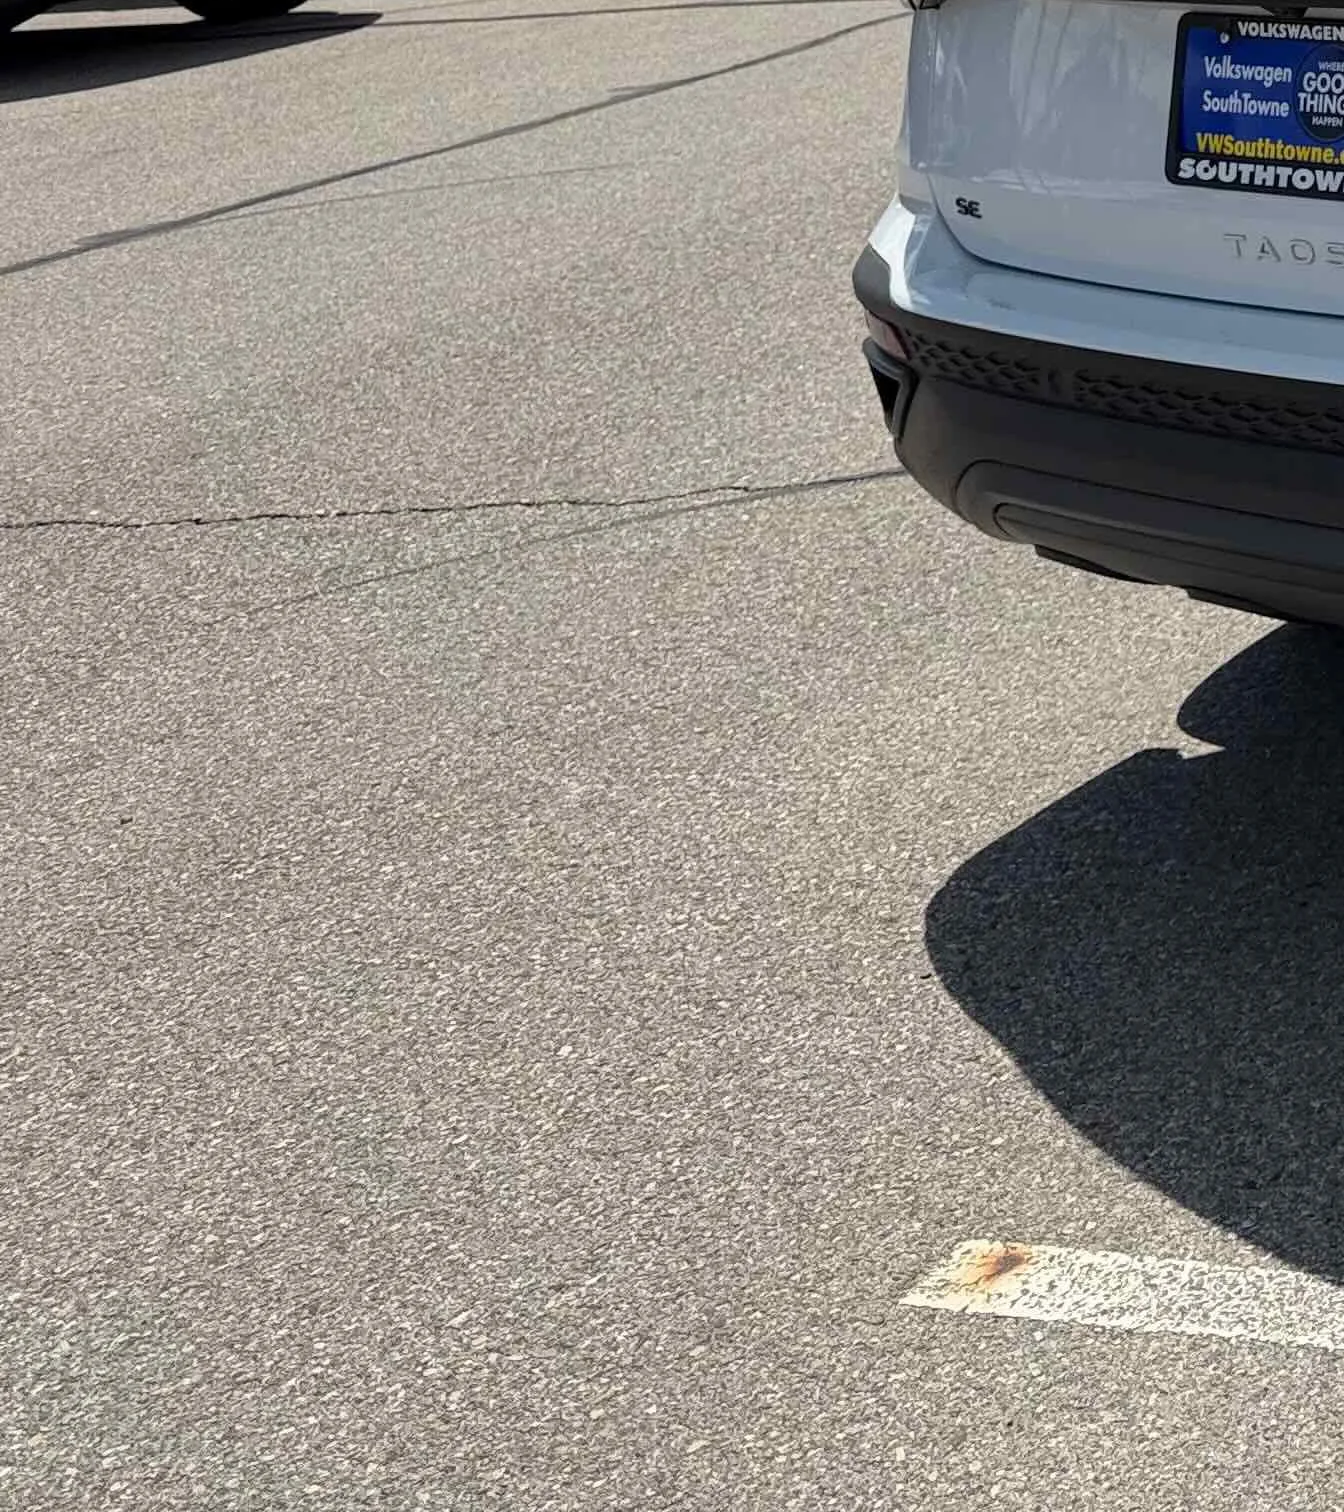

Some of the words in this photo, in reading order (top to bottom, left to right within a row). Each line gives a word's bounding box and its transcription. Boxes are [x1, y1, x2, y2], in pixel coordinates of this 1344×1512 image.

[1203, 55, 1292, 88] Volkswagen
[1202, 89, 1290, 118] SouthTowne
[1311, 115, 1344, 128] HAPPEN
[955, 196, 982, 219] SE
